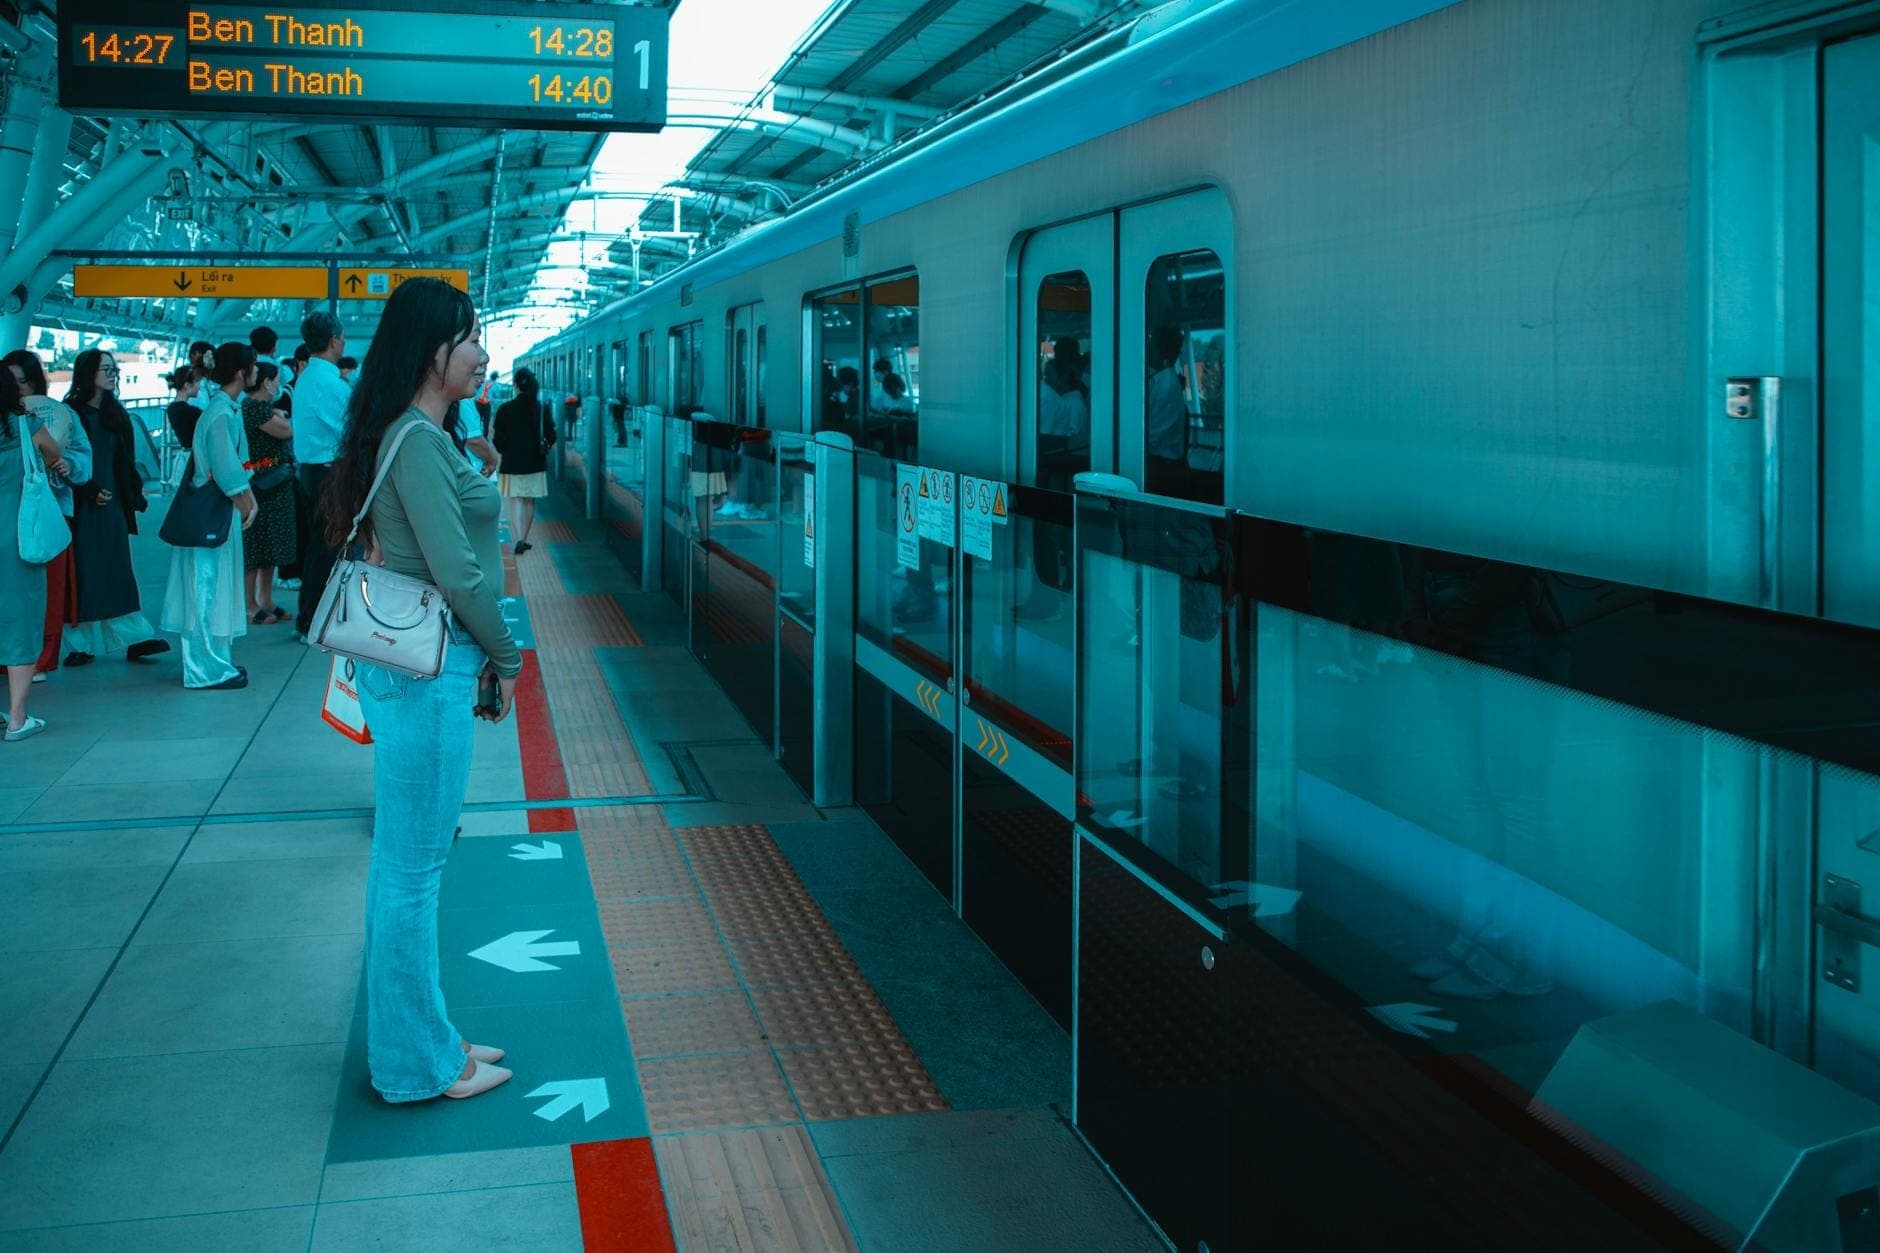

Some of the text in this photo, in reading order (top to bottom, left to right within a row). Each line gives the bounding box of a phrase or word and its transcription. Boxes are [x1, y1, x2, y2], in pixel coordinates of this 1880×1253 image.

[82, 31, 174, 64] 14:27
[188, 11, 613, 57] Ben Thanh 14:28
[189, 61, 612, 105] Ben Thanh 14:40
[633, 40, 650, 90] 1
[171, 209, 190, 219] EXIT
[221, 273, 234, 282] ra
